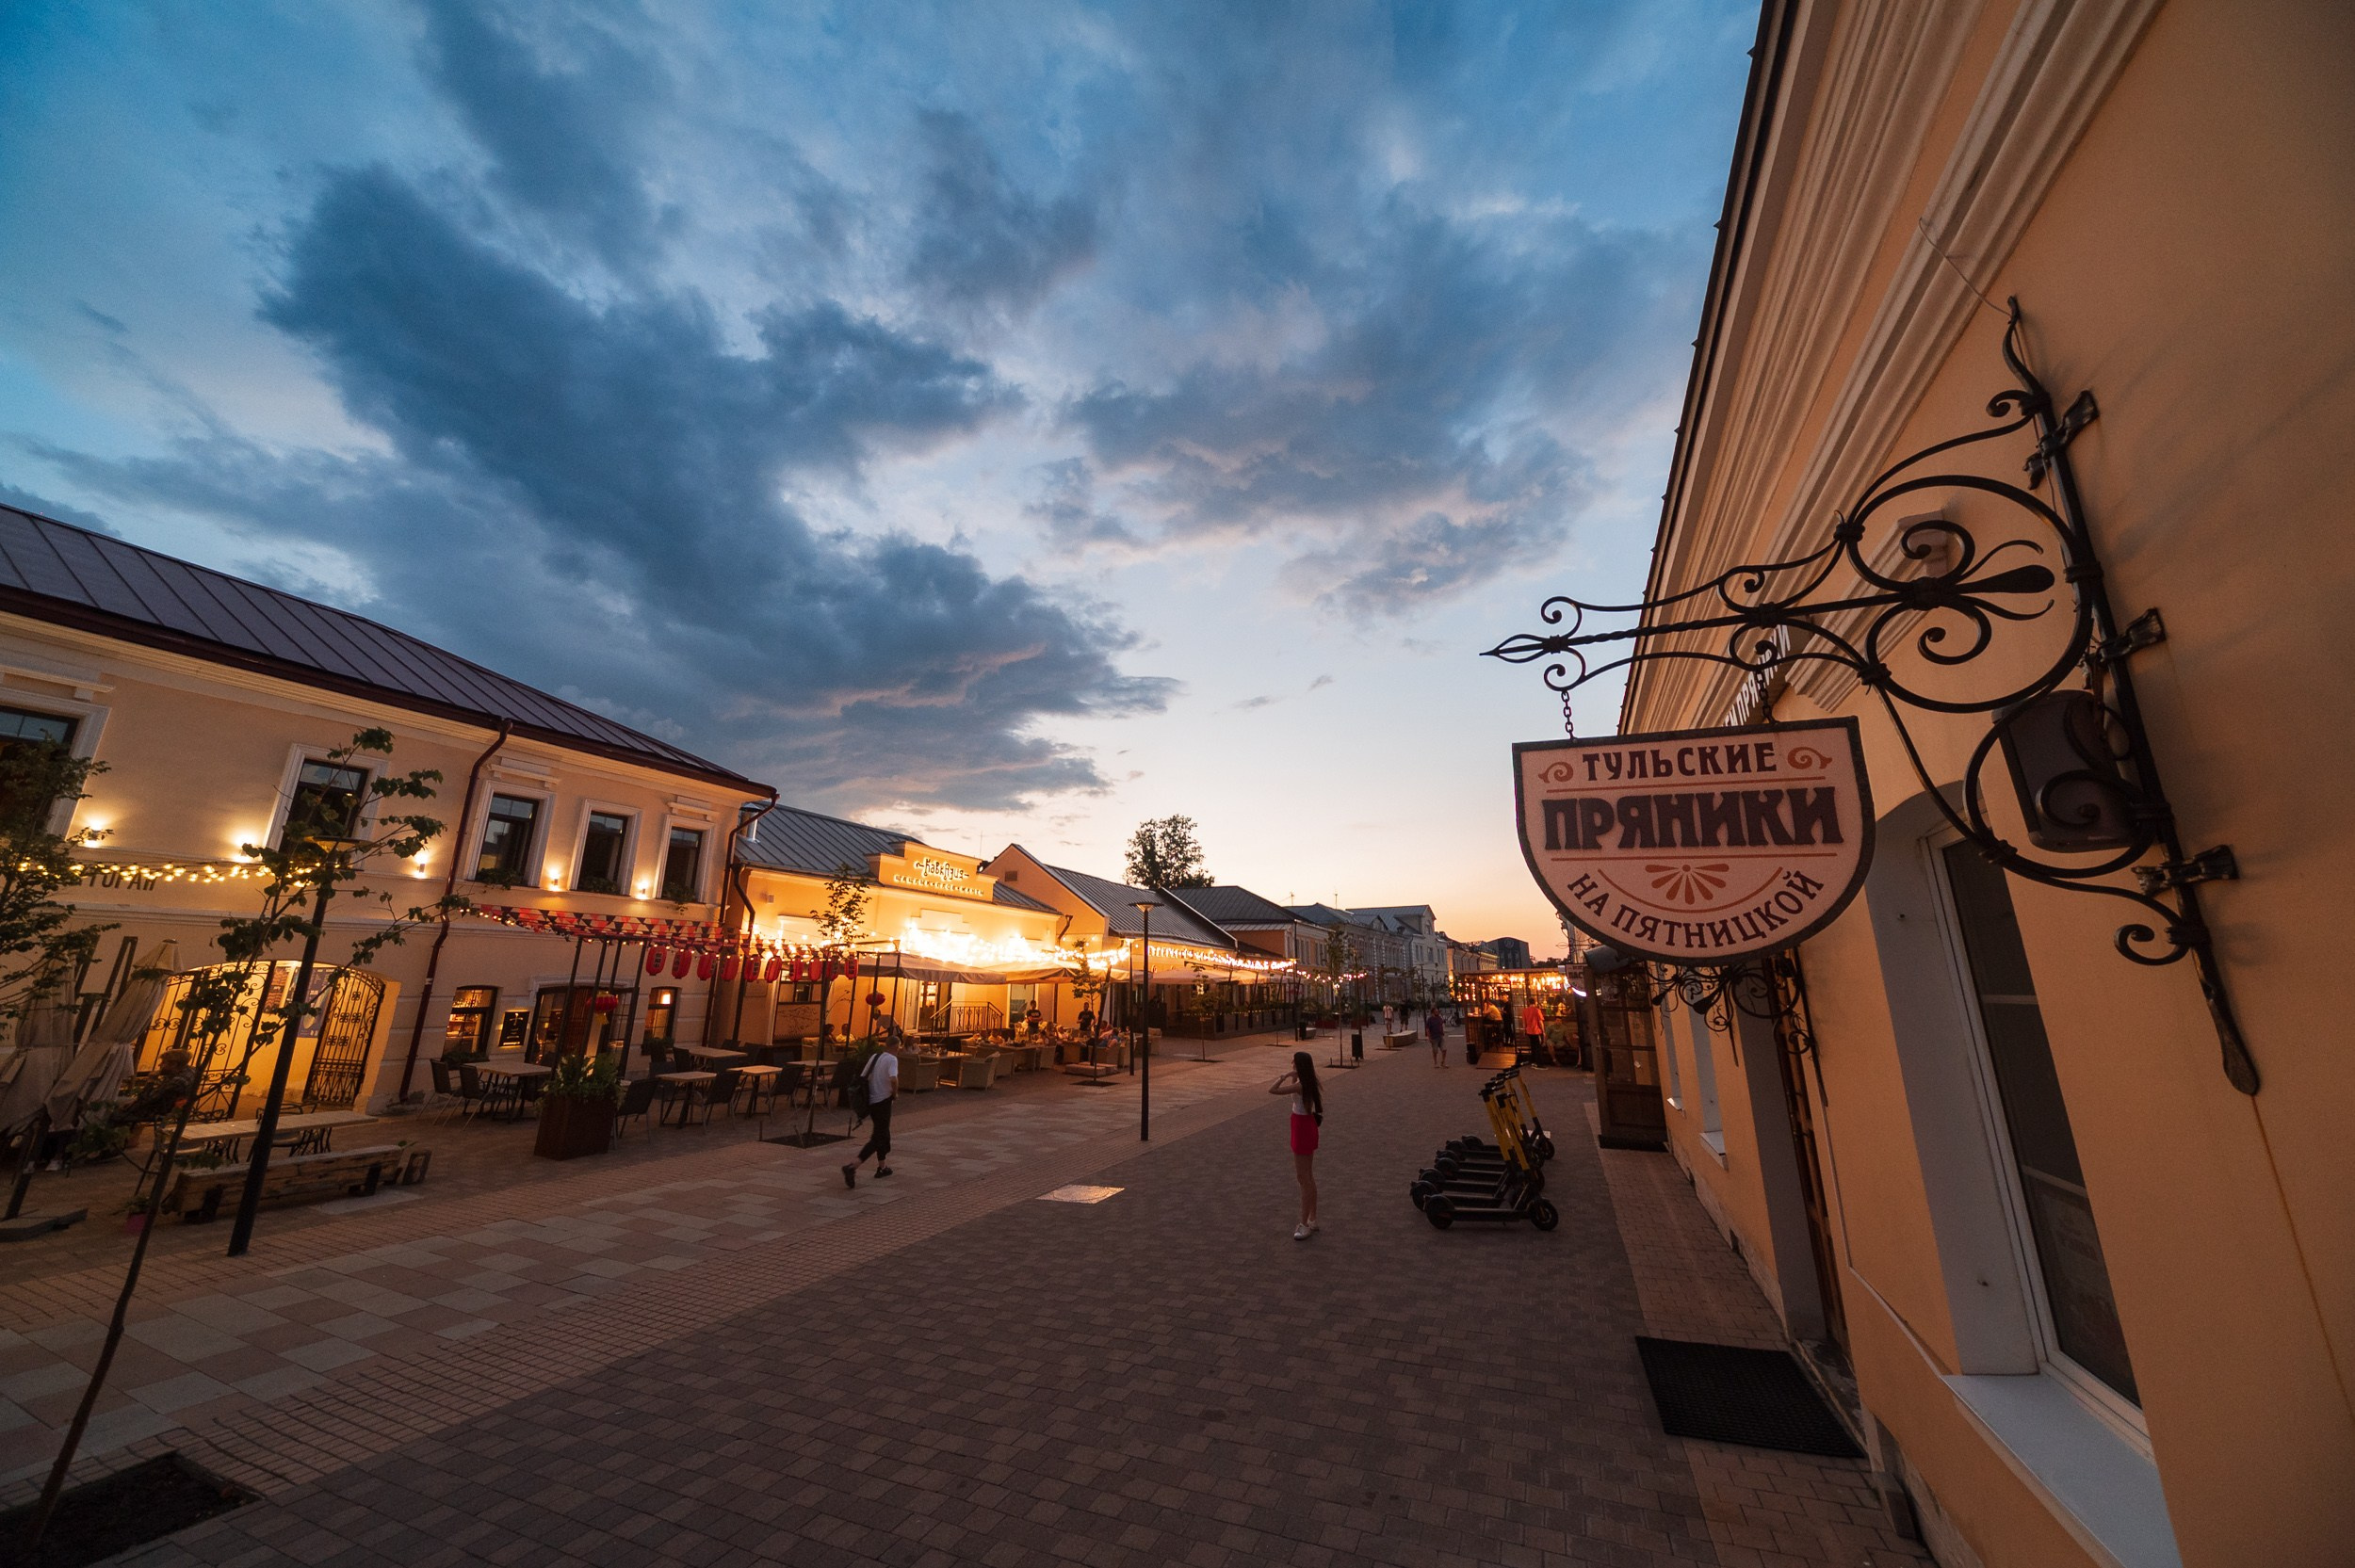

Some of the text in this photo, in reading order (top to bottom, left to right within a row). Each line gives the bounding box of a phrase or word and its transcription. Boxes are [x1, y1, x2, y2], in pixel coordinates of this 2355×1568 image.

[1583, 742, 1778, 782] ТУЛЬСКИЕ
[1541, 786, 1844, 850] ПРЯНИКИ
[1567, 870, 1825, 949] НА ПЯТНИЦКОЙ
